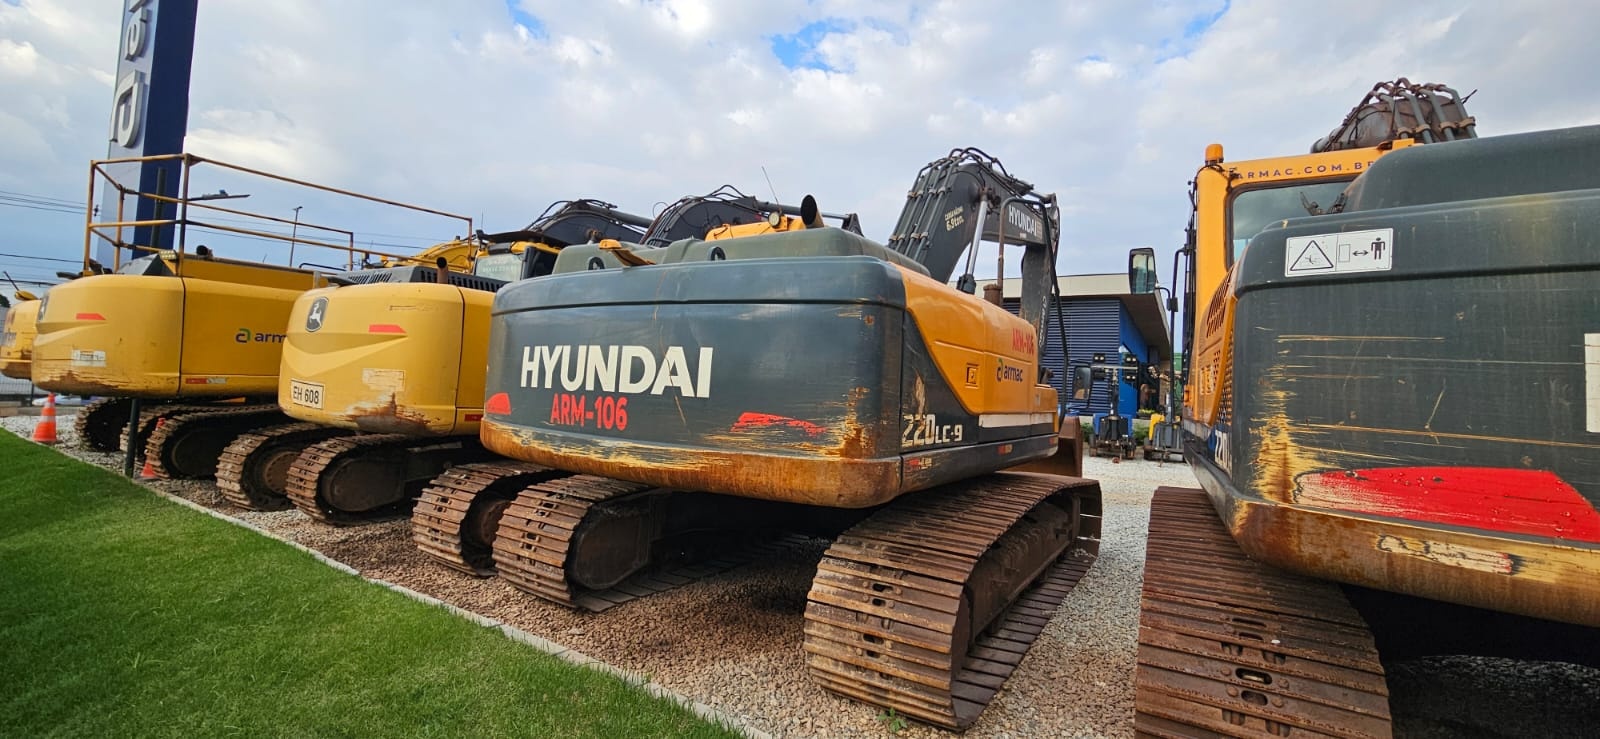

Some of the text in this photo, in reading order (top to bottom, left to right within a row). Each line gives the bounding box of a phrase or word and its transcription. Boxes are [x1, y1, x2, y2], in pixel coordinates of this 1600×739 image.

[1008, 204, 1037, 236] HYUNDAI
[520, 345, 713, 398] HYUNDAI
[1003, 365, 1023, 382] armac
[293, 386, 319, 404] EH 608
[550, 393, 628, 431] ARM-106
